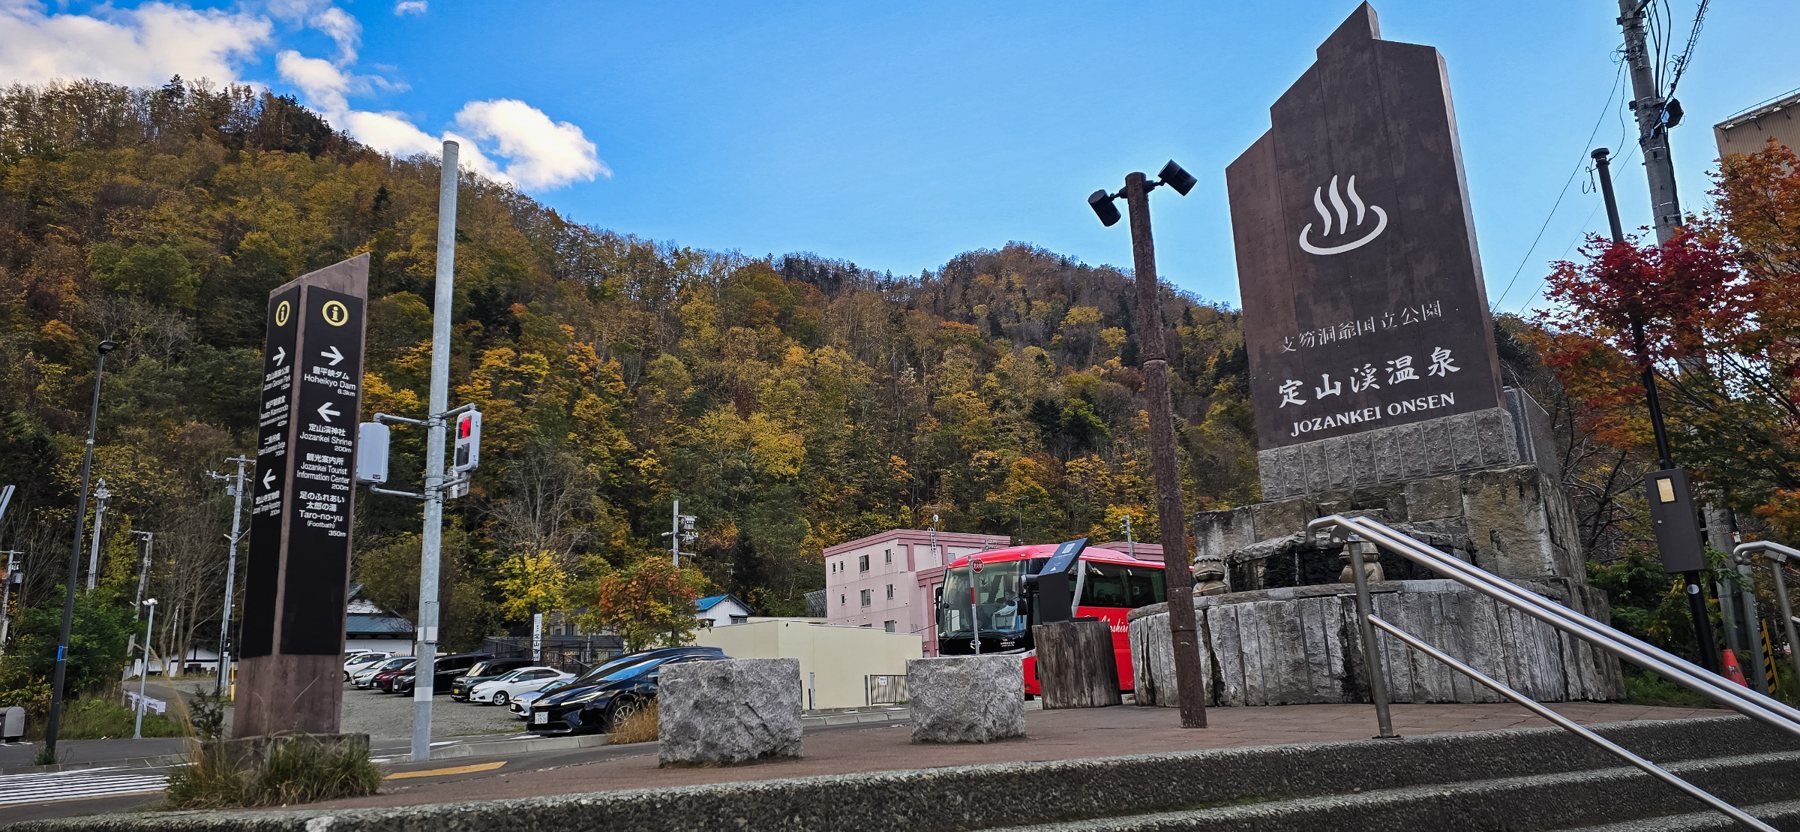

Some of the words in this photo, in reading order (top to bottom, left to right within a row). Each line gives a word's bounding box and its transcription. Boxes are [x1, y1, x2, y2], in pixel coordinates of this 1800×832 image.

[304, 373, 338, 387] Hoheikyo
[339, 380, 356, 390] Dam
[1278, 346, 1461, 408] 定山渓温泉
[1290, 406, 1382, 437] JOZANKEI
[1387, 392, 1455, 416] ONSEN
[299, 431, 330, 443] Jozankei
[331, 436, 353, 447] Shrine
[334, 445, 352, 453] 200m
[300, 462, 327, 472] Jozankei
[328, 465, 348, 475] Tourist
[296, 470, 329, 481] Information
[330, 474, 350, 484] Center
[331, 483, 349, 491] 200m
[299, 490, 345, 503] 足のふれあい
[298, 509, 344, 522] Taro-no-yu
[306, 519, 336, 529] (Footbath)
[328, 529, 347, 537] 350m
